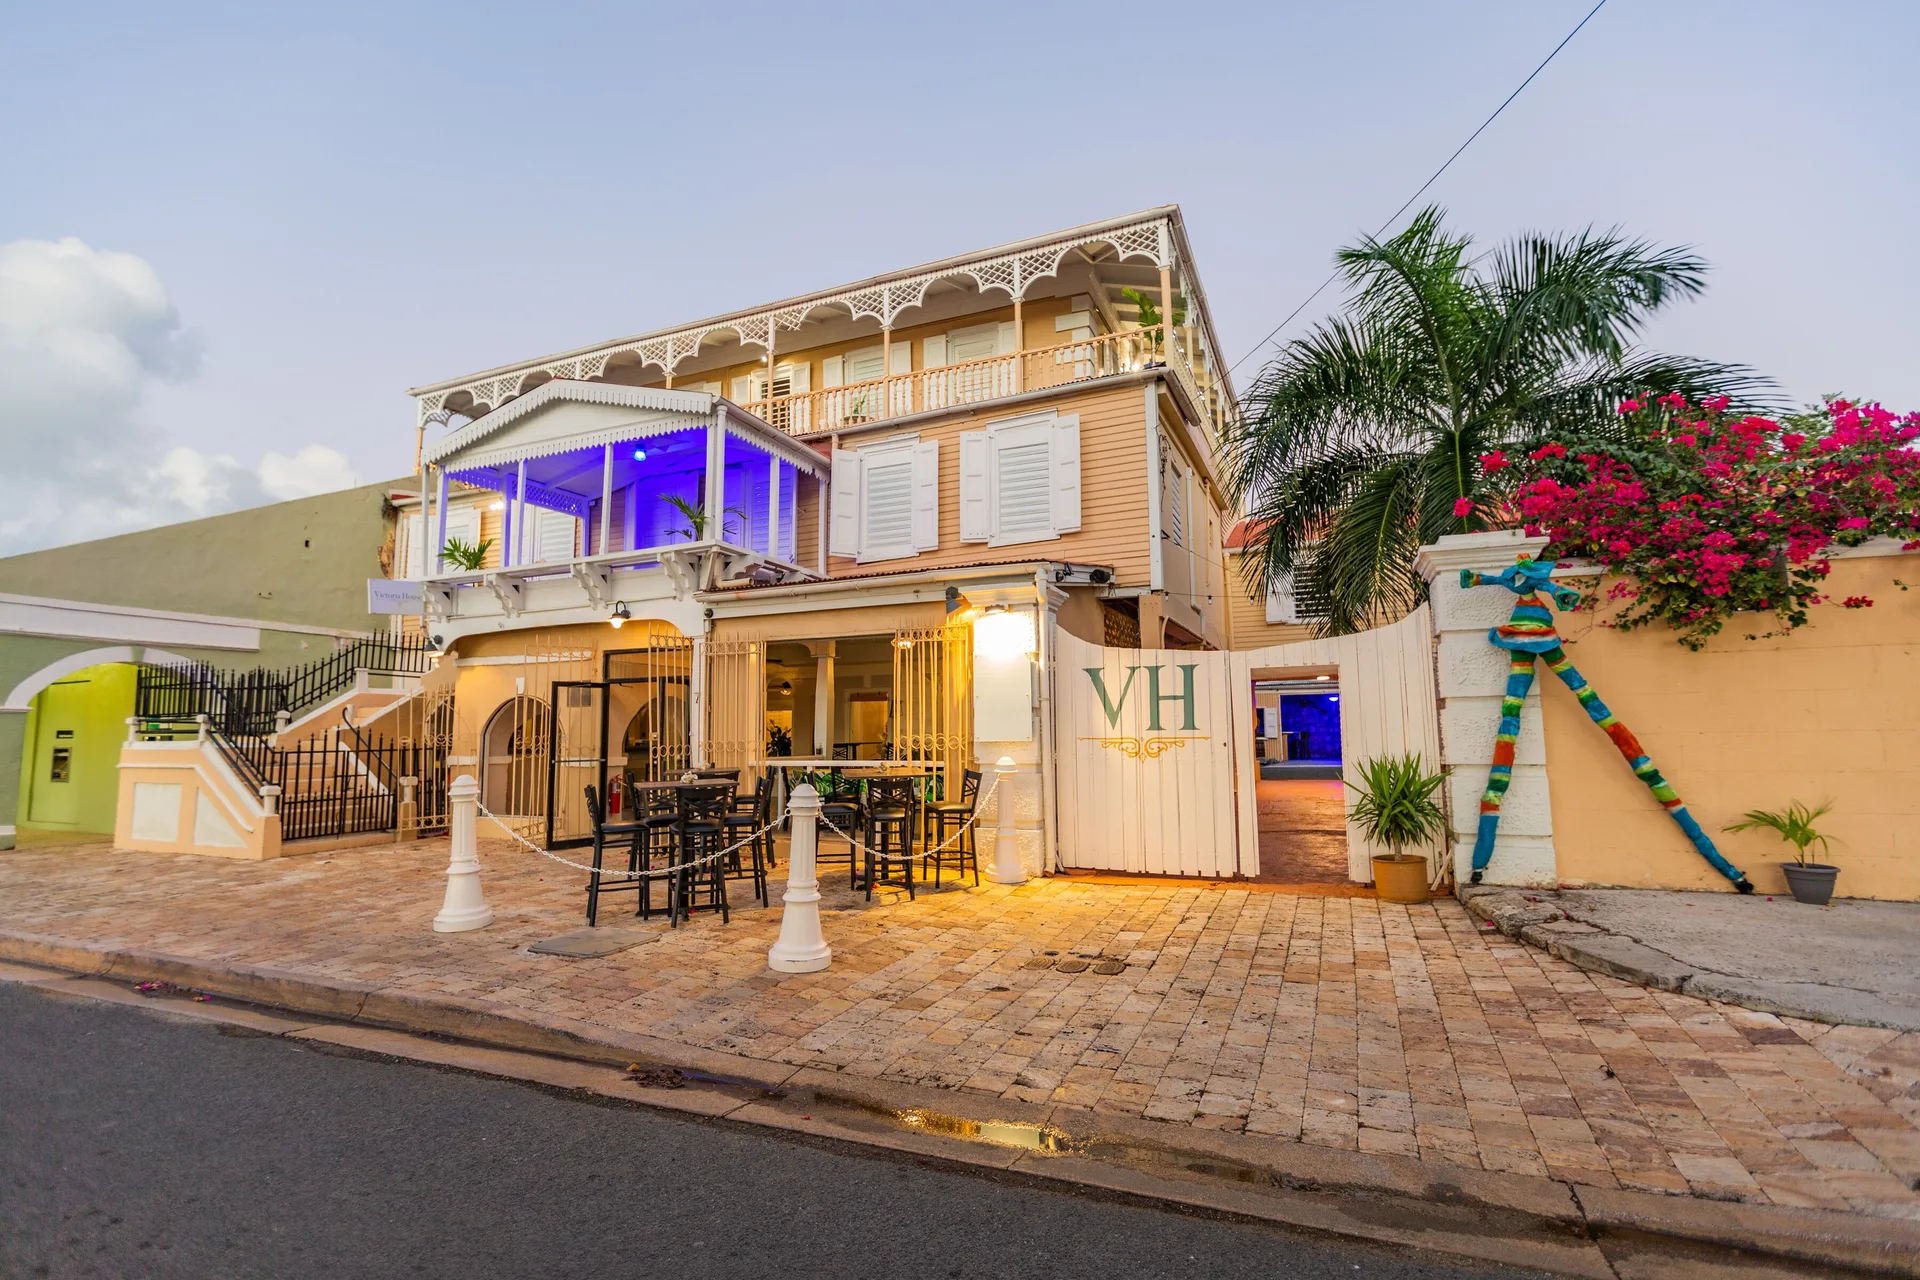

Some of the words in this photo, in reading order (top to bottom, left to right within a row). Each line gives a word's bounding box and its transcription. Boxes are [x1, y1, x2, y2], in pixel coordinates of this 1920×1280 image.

[374, 590, 401, 599] Victoria
[402, 592, 423, 600] House
[1082, 664, 1201, 731] VH
